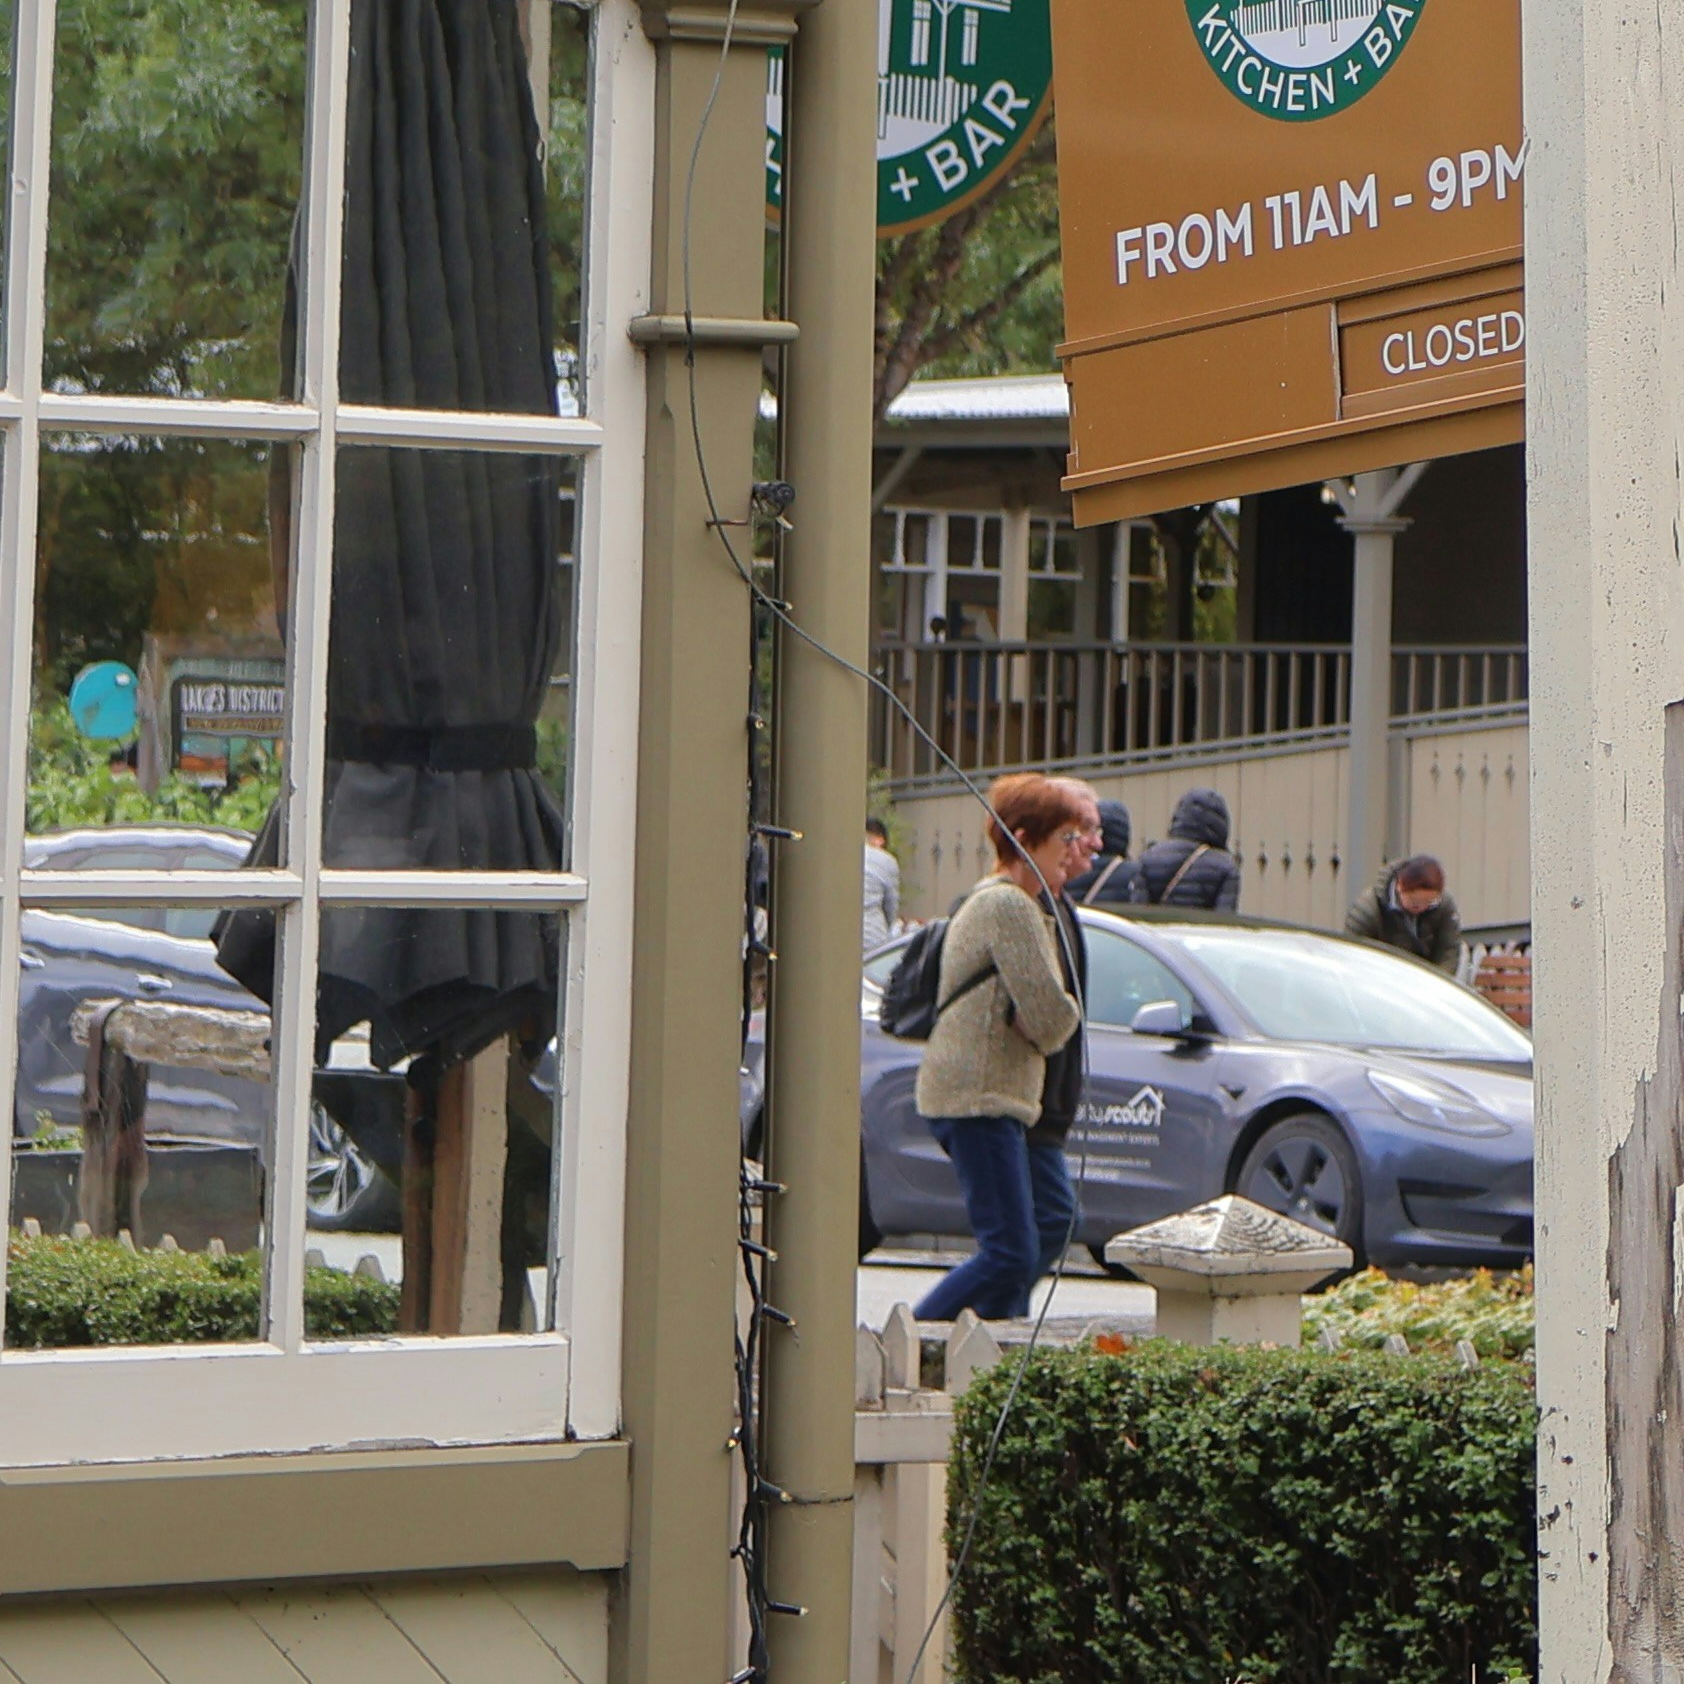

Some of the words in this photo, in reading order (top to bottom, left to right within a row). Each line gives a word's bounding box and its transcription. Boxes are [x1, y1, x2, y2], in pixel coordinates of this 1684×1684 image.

[1197, 2, 1336, 112] KITCHEN
[925, 78, 1032, 193] BAR
[1115, 201, 1254, 286] FROM
[1265, 173, 1379, 251] 11AM
[1427, 139, 1526, 212] 9PM
[1381, 310, 1526, 376] CLOSED
